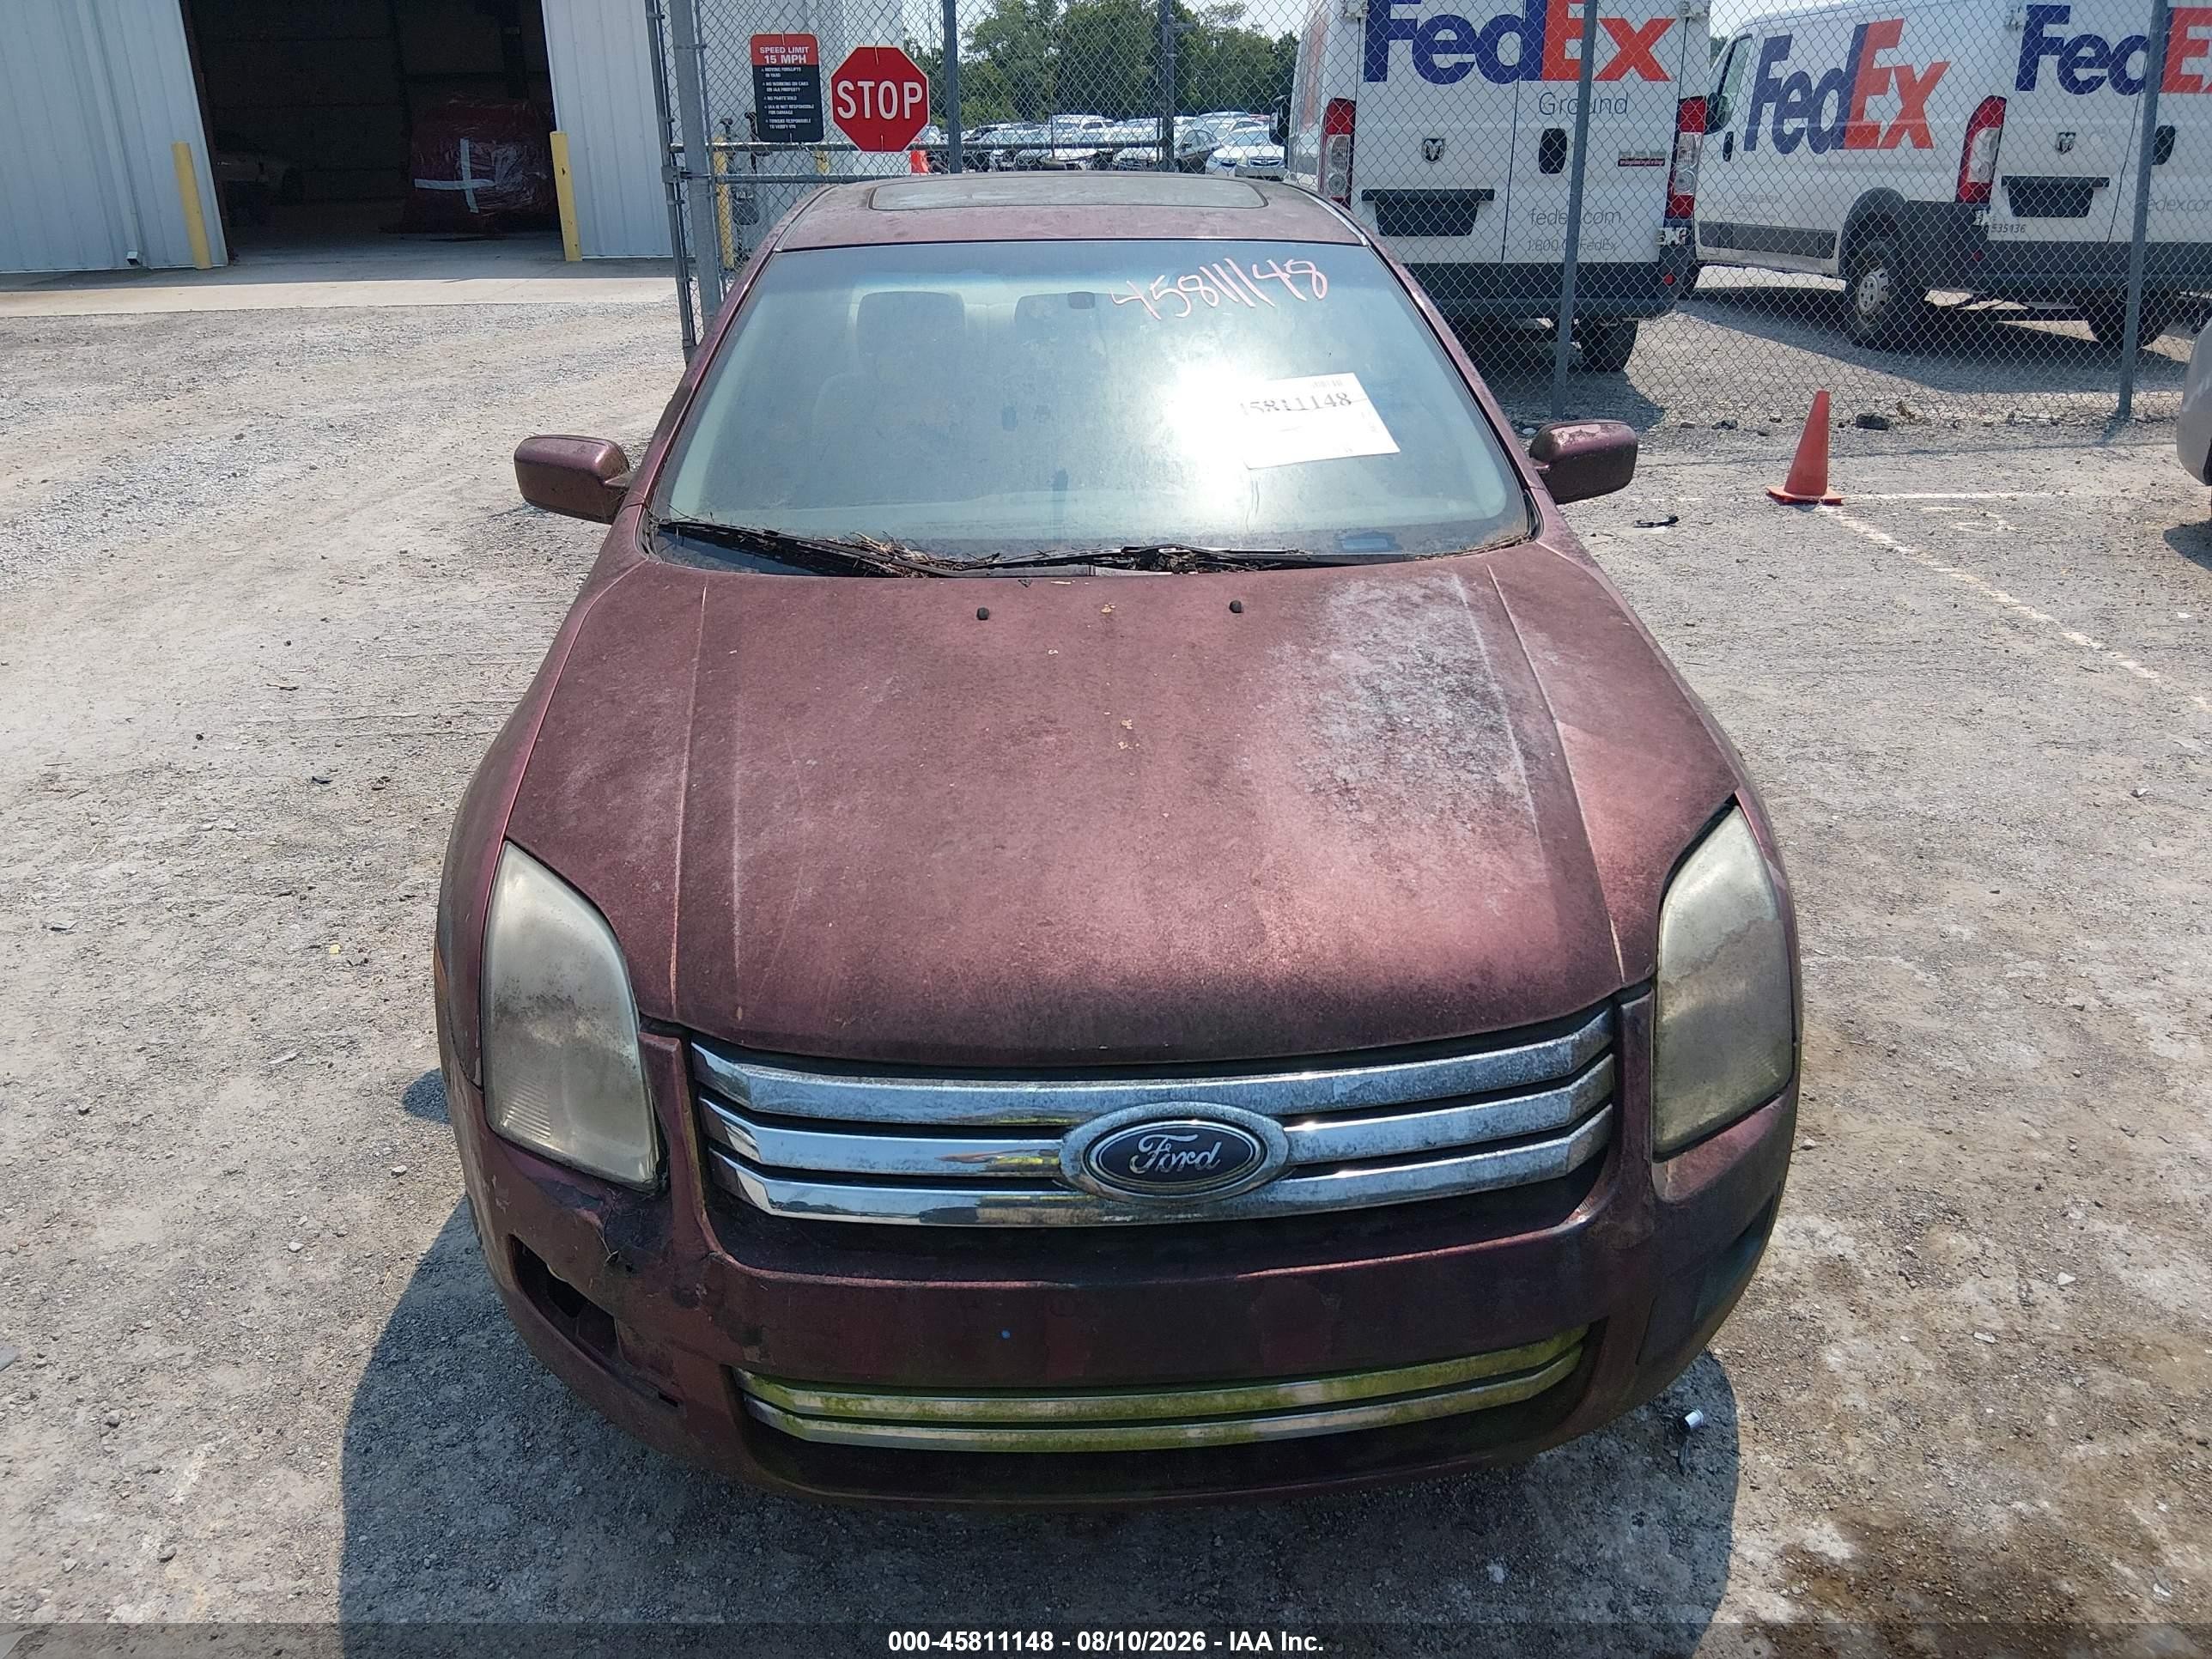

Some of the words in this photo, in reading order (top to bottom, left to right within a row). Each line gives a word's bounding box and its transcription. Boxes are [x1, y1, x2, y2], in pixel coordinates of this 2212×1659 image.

[764, 55, 777, 64] 15
[781, 55, 806, 64] MPH
[1363, 0, 1676, 84] FedEx
[2015, 4, 2212, 95] FedE
[836, 80, 923, 120] STOP
[1743, 18, 1951, 155] FedEx
[1109, 258, 1328, 319] 45811148
[1129, 1133, 1222, 1174] Ford
